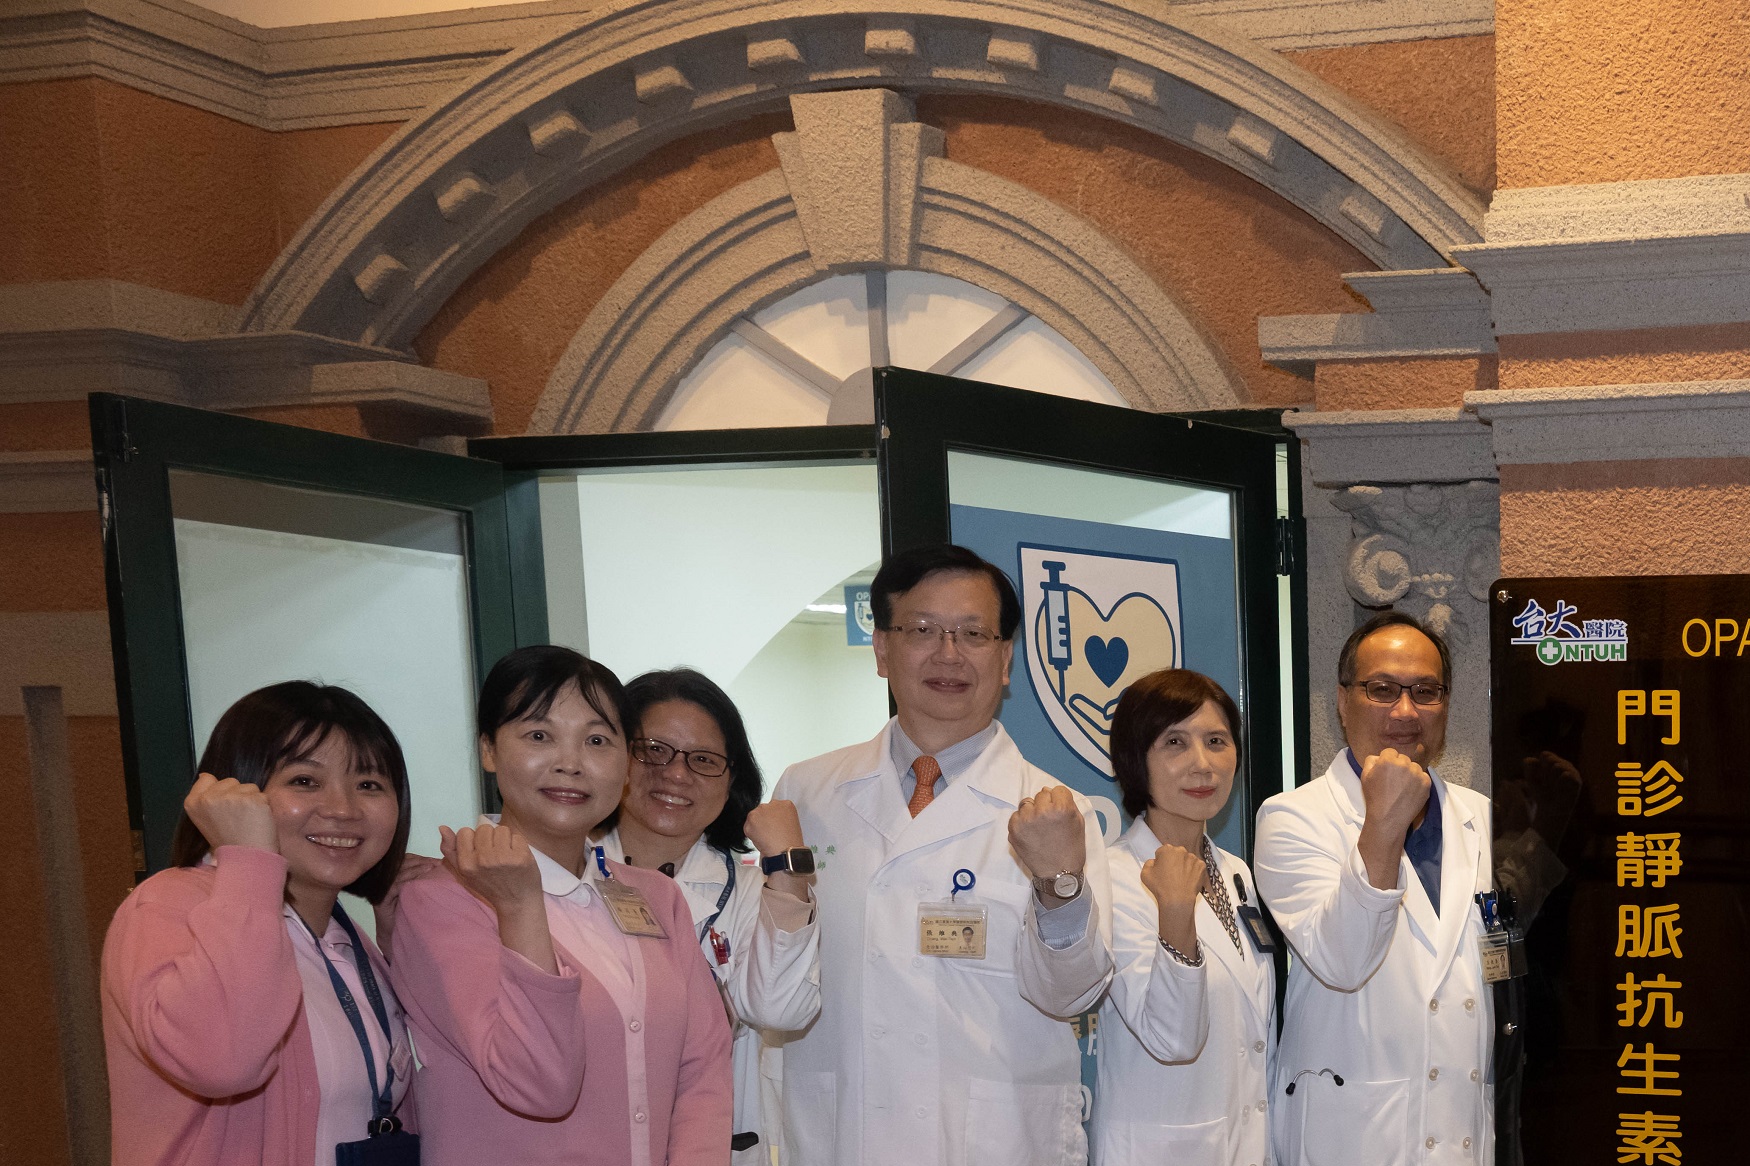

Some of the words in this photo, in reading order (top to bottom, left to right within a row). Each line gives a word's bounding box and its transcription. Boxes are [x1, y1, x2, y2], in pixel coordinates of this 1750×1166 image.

[1513, 599, 1628, 639] 台大醫院
[1564, 643, 1627, 661] NTUH
